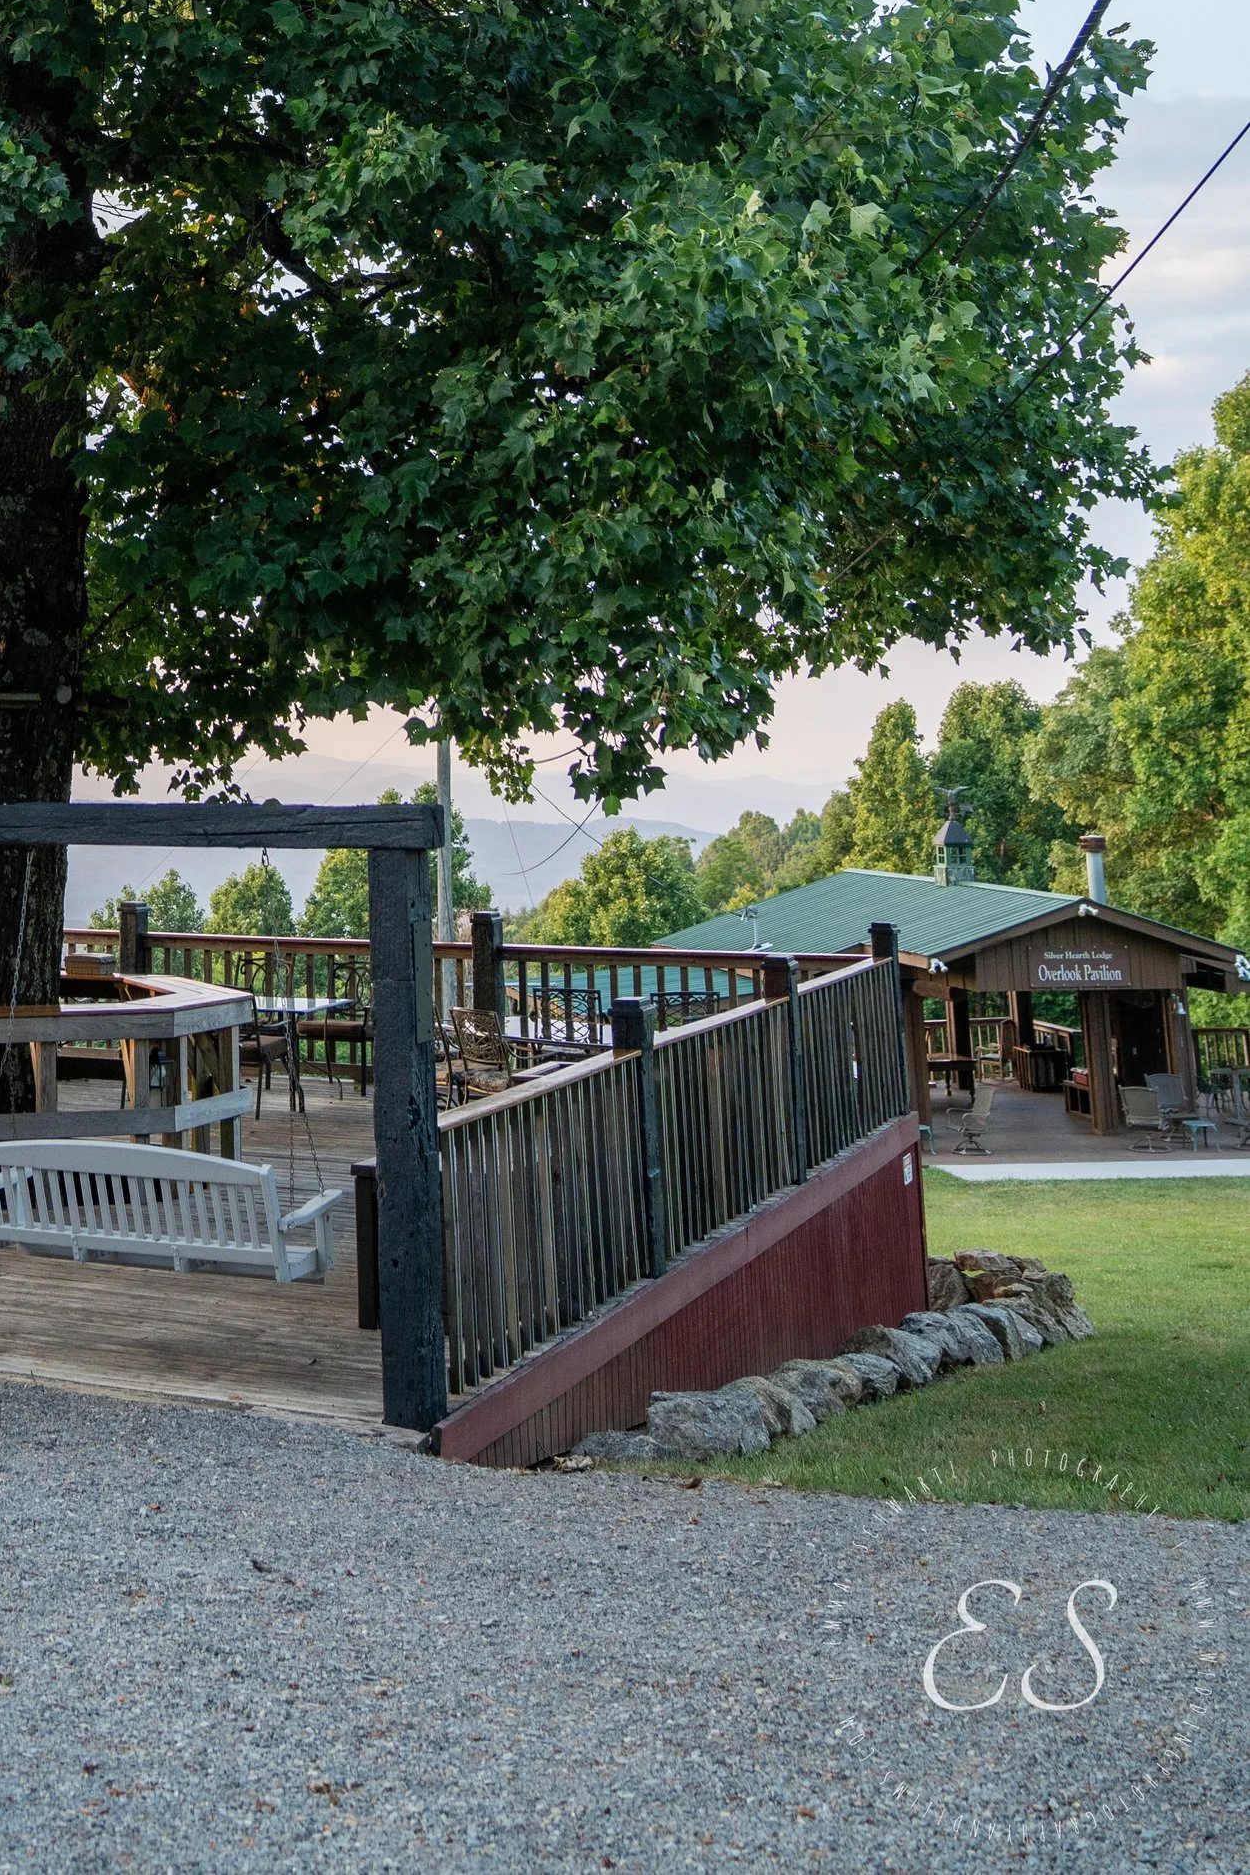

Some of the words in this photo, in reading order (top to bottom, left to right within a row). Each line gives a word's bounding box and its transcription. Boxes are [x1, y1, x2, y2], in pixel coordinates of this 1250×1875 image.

[1043, 951, 1064, 960] Silver
[1065, 951, 1090, 960] Hearth
[1092, 951, 1113, 960] Lodge
[1038, 964, 1082, 981] Overlook
[1084, 964, 1122, 981] Pavilion
